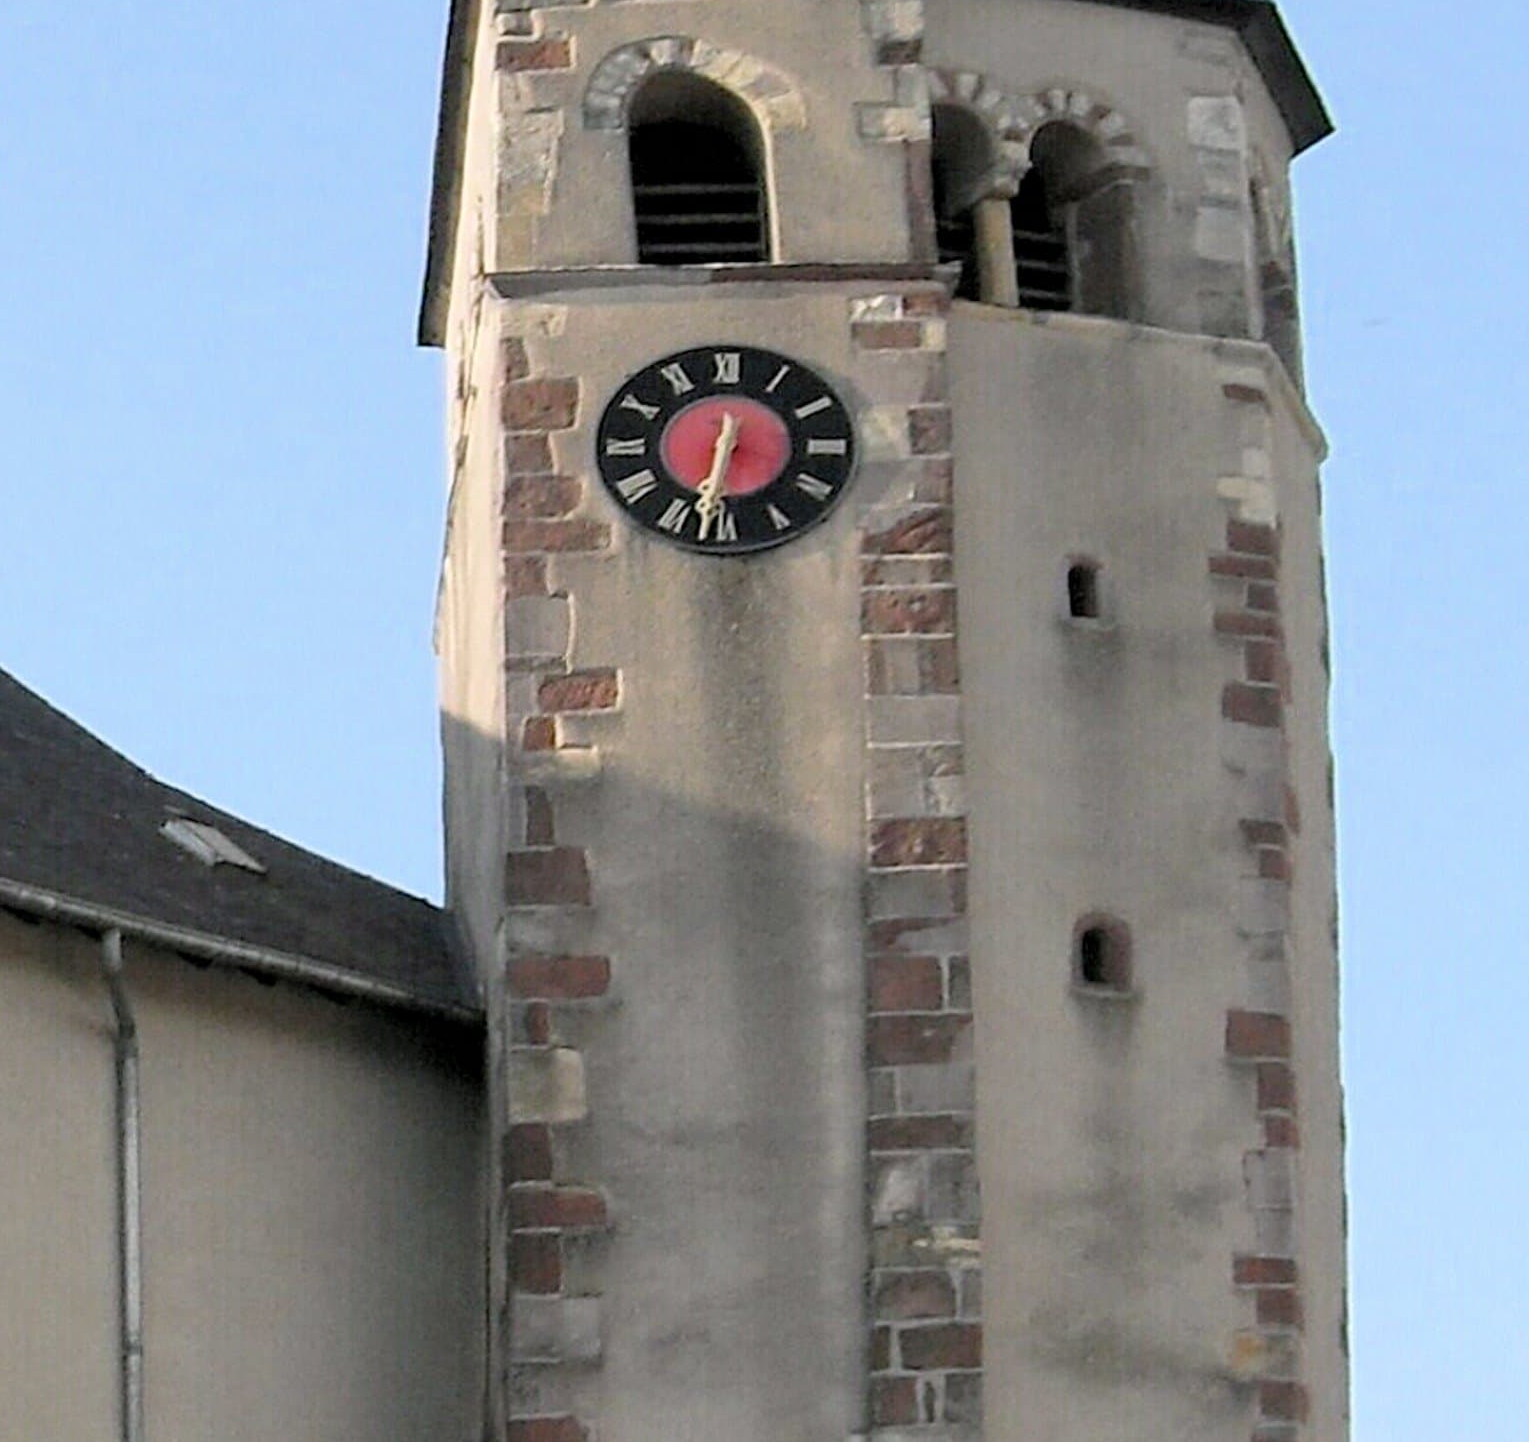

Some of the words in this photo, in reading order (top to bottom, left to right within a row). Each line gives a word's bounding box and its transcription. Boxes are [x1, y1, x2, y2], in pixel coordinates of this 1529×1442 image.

[660, 363, 695, 394] XI
[713, 353, 740, 385] XII
[765, 365, 790, 392] I
[619, 394, 661, 420] X
[606, 438, 645, 456] IX
[795, 473, 833, 501] IV
[658, 498, 691, 534] VII
[767, 504, 791, 530] V
